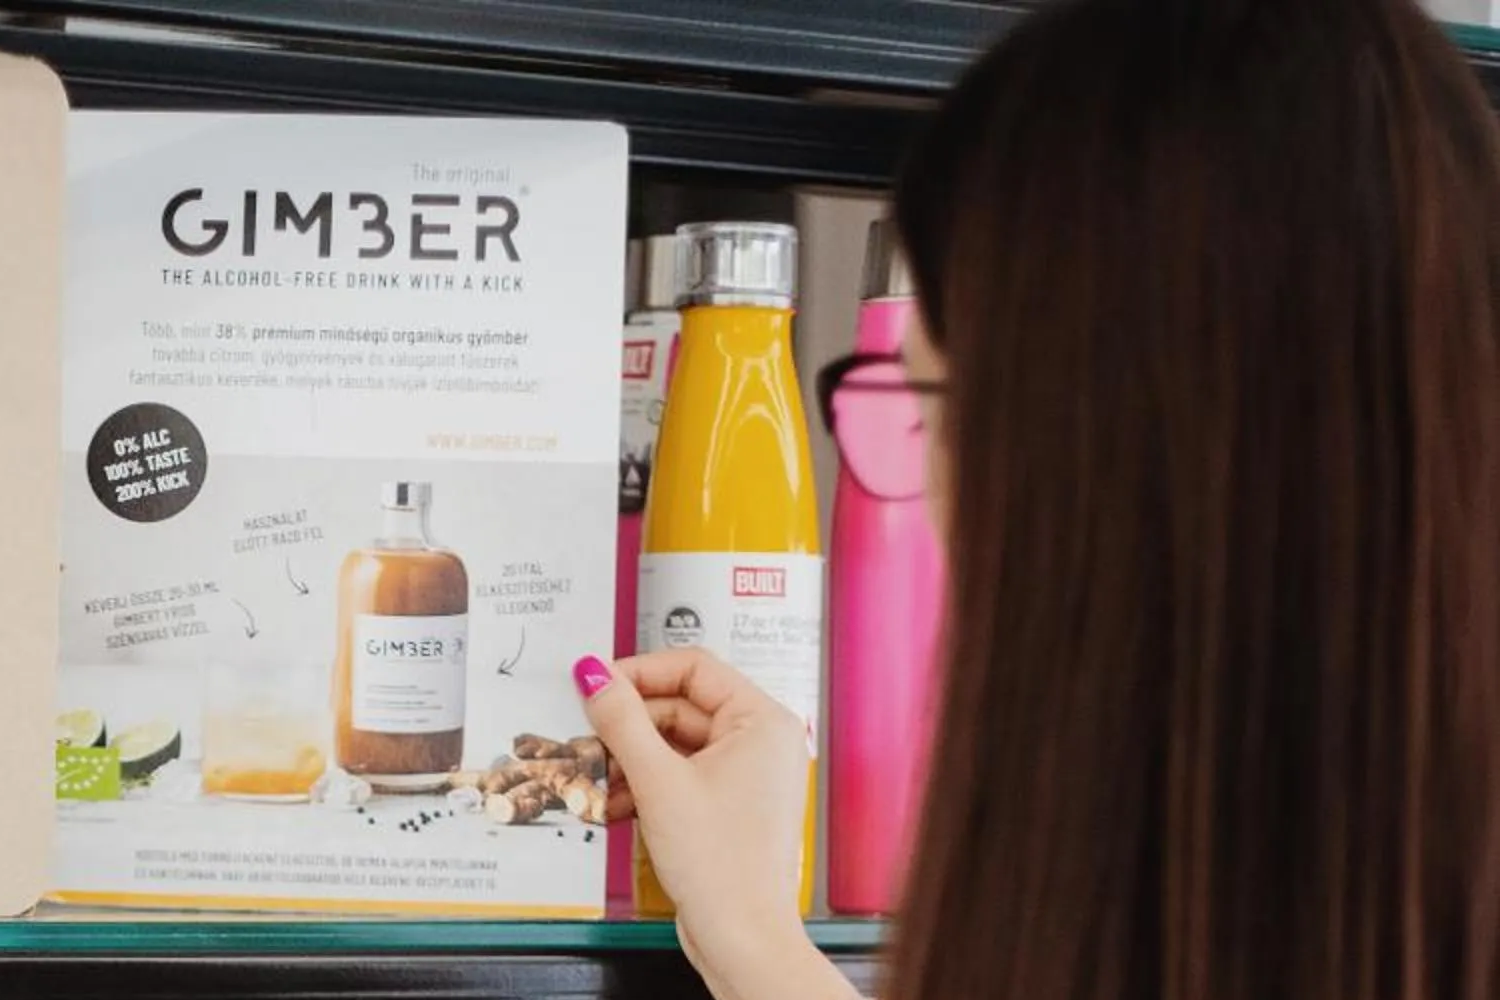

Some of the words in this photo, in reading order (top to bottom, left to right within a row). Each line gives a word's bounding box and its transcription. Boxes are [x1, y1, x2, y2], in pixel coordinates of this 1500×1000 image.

[411, 161, 440, 181] The
[444, 163, 510, 187] original
[161, 188, 521, 262] GIMBER
[161, 269, 193, 286] THE
[346, 271, 401, 289] DRINK
[409, 273, 454, 290] WITH
[463, 274, 474, 290] A
[482, 275, 524, 292] KICK
[113, 436, 140, 457] 0%
[142, 428, 171, 450] ALC
[103, 458, 144, 482] 100%
[145, 446, 192, 471] TASTE
[115, 479, 156, 502] 200%
[156, 470, 190, 492] KICK
[737, 569, 785, 594] BUILT
[366, 638, 444, 659] GIMBER
